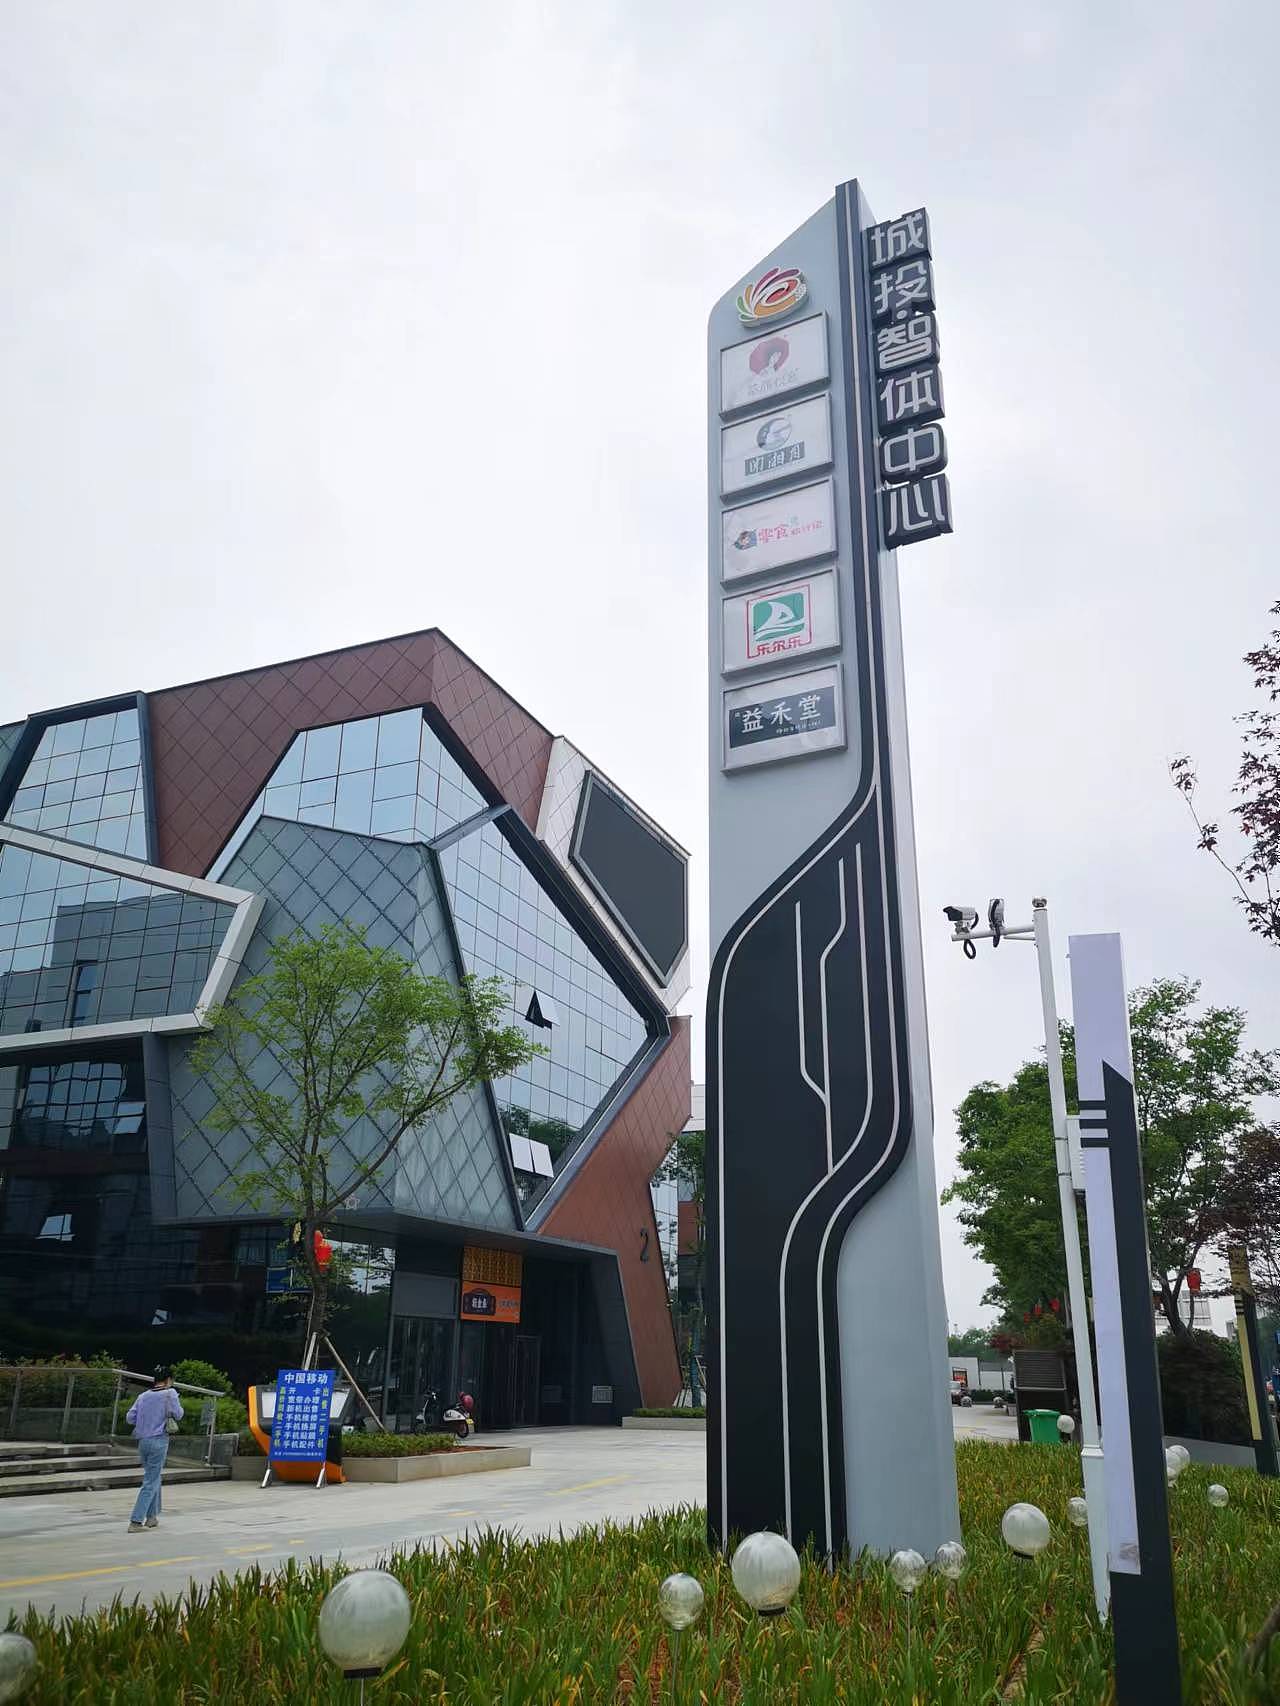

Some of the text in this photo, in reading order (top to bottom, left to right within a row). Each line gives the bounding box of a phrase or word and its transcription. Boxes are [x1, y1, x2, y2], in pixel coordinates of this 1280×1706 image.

[741, 694, 821, 733] 益禾堂
[640, 1227, 649, 1263] 2
[285, 1373, 328, 1384] 中国移动
[283, 1440, 315, 1449] 手机配件
